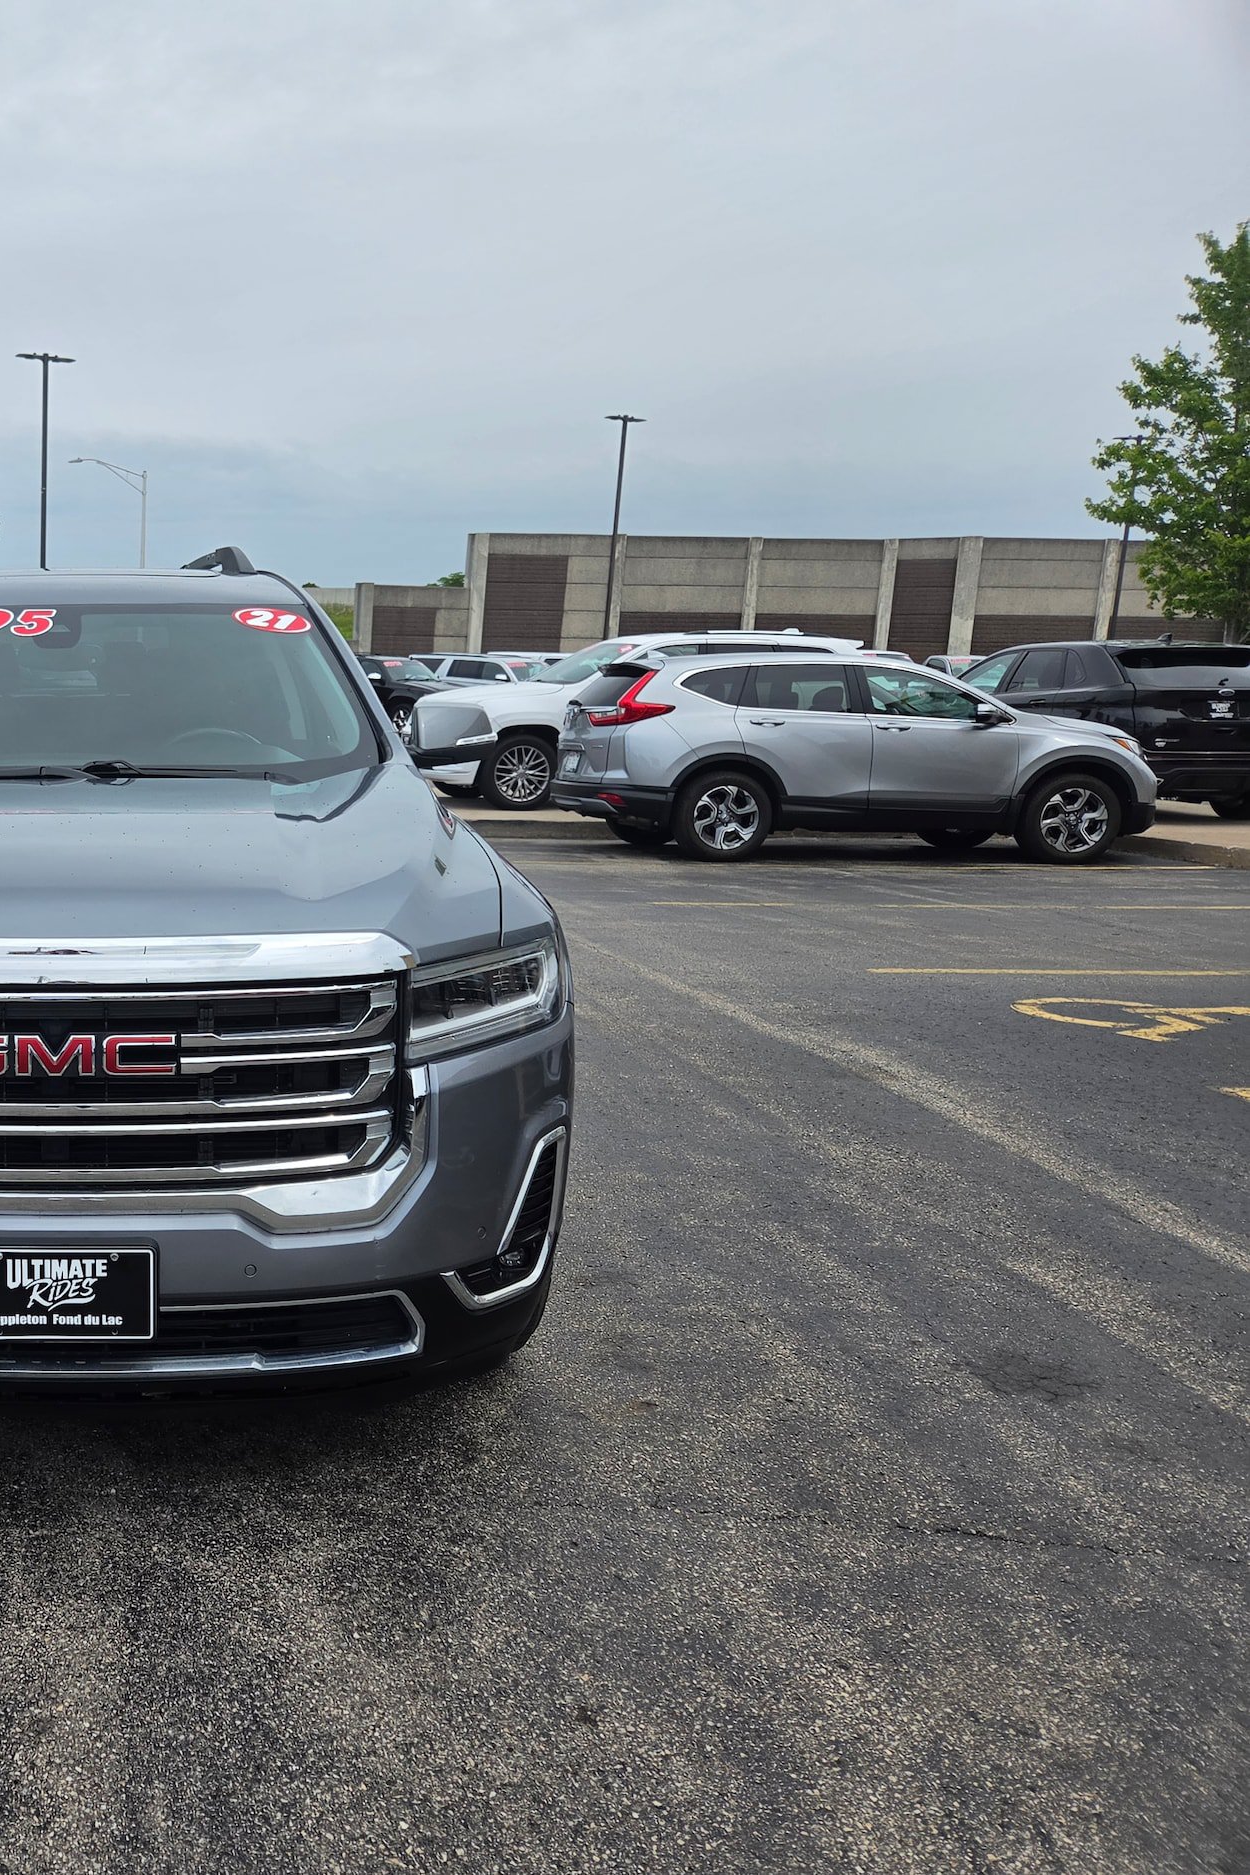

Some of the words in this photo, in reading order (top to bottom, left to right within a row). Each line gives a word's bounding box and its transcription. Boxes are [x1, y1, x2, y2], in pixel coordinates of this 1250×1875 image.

[245, 610, 298, 630] 21
[6, 1258, 108, 1290] ULTIMATE
[52, 1314, 82, 1326] Fond
[84, 1314, 100, 1326] du
[102, 1314, 123, 1326] Lac
